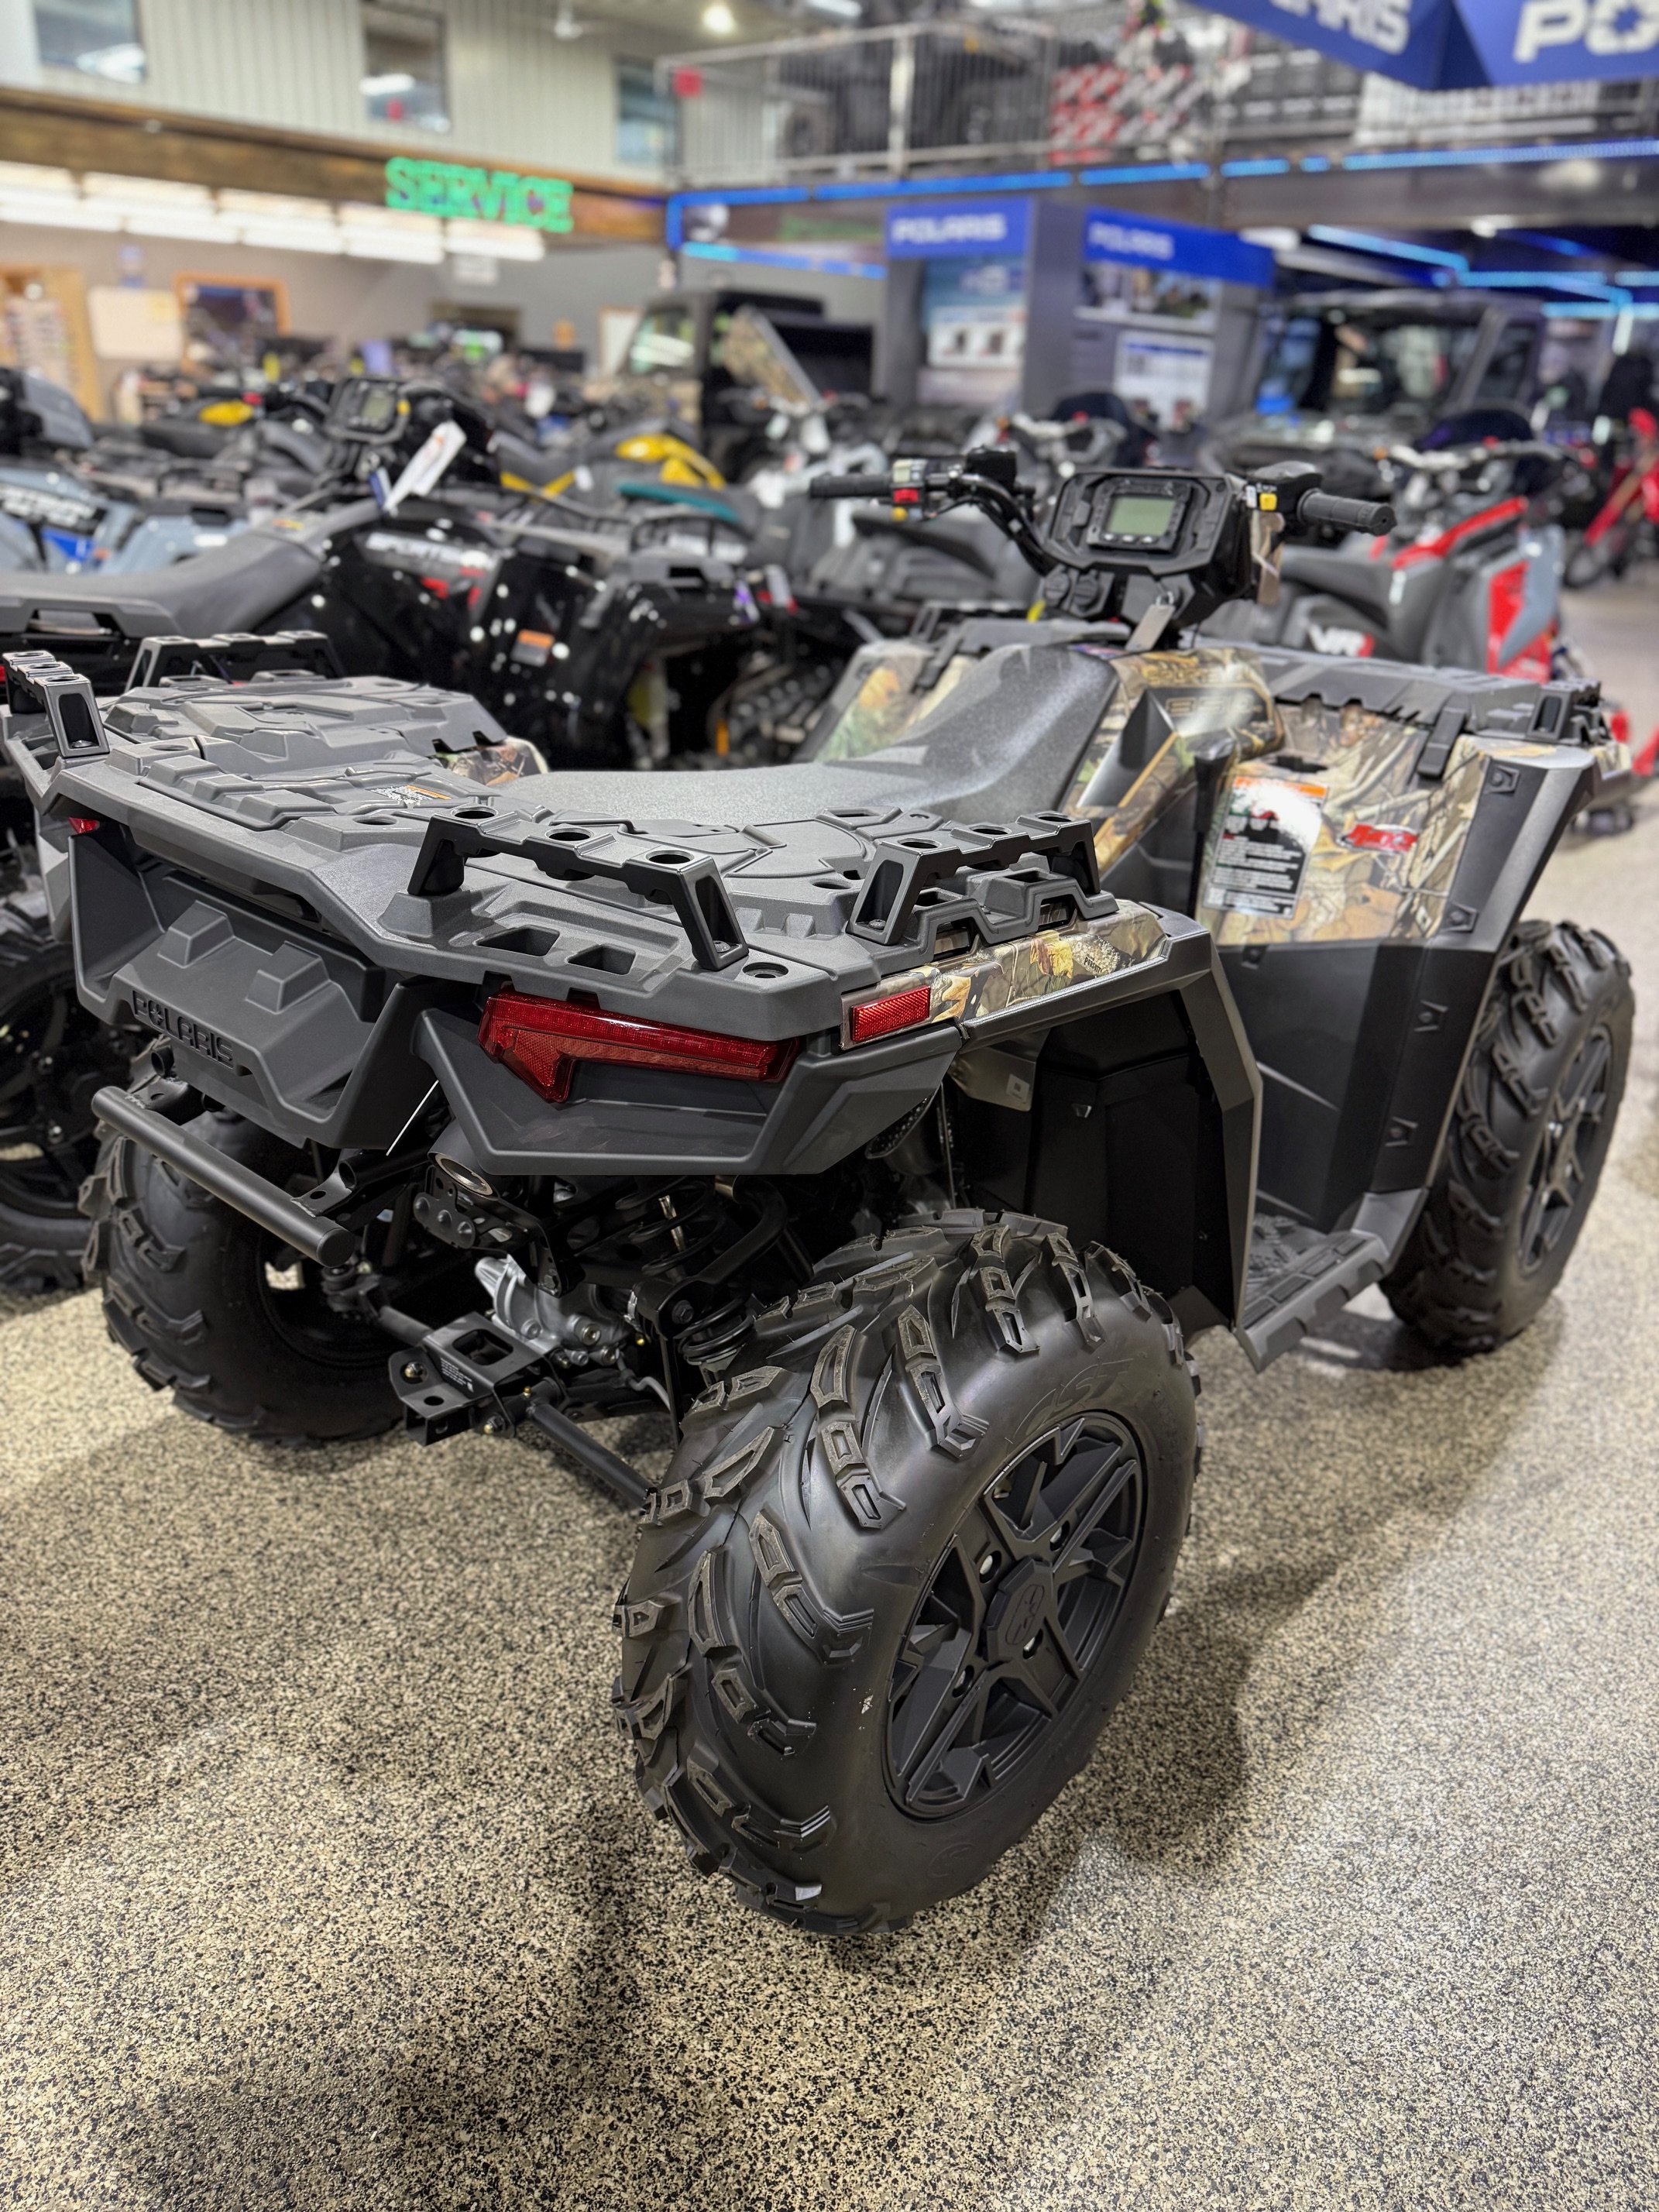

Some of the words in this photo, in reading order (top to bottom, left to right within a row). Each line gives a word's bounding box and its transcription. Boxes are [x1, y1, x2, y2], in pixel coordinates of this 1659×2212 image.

[386, 156, 573, 233] SERVICE
[891, 213, 1008, 246] POLARIS
[132, 990, 235, 1070] POLARIS
